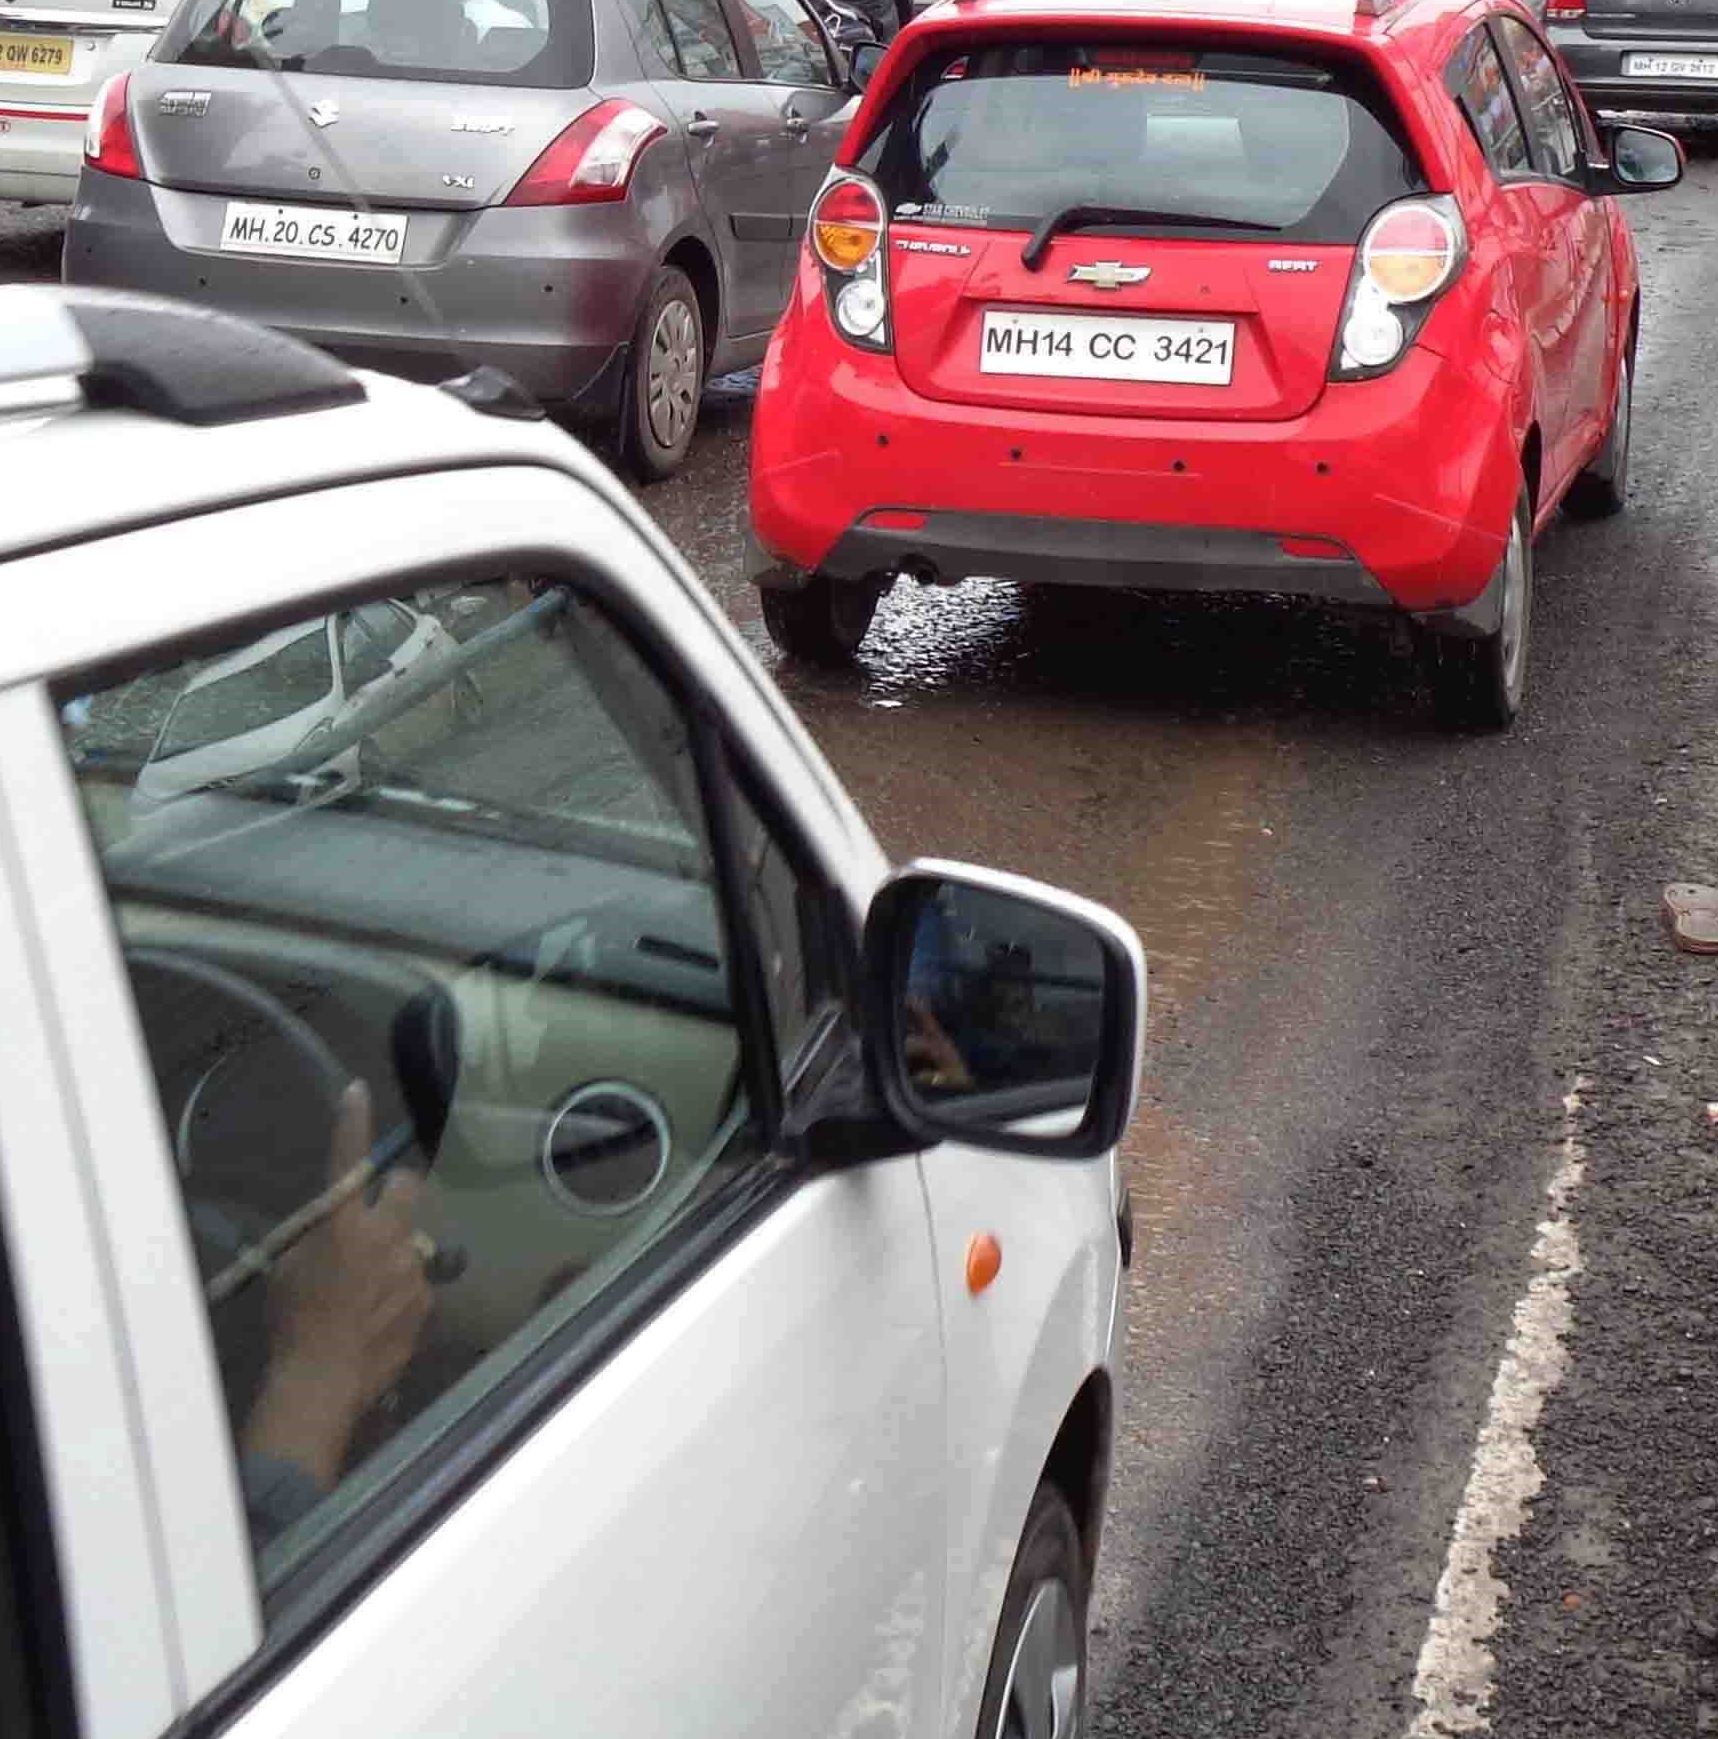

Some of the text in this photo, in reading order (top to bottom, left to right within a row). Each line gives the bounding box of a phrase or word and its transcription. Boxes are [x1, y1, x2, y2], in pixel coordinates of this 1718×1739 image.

[31, 46, 63, 66] 6279
[987, 328, 1229, 366] MH14 CC 3421
